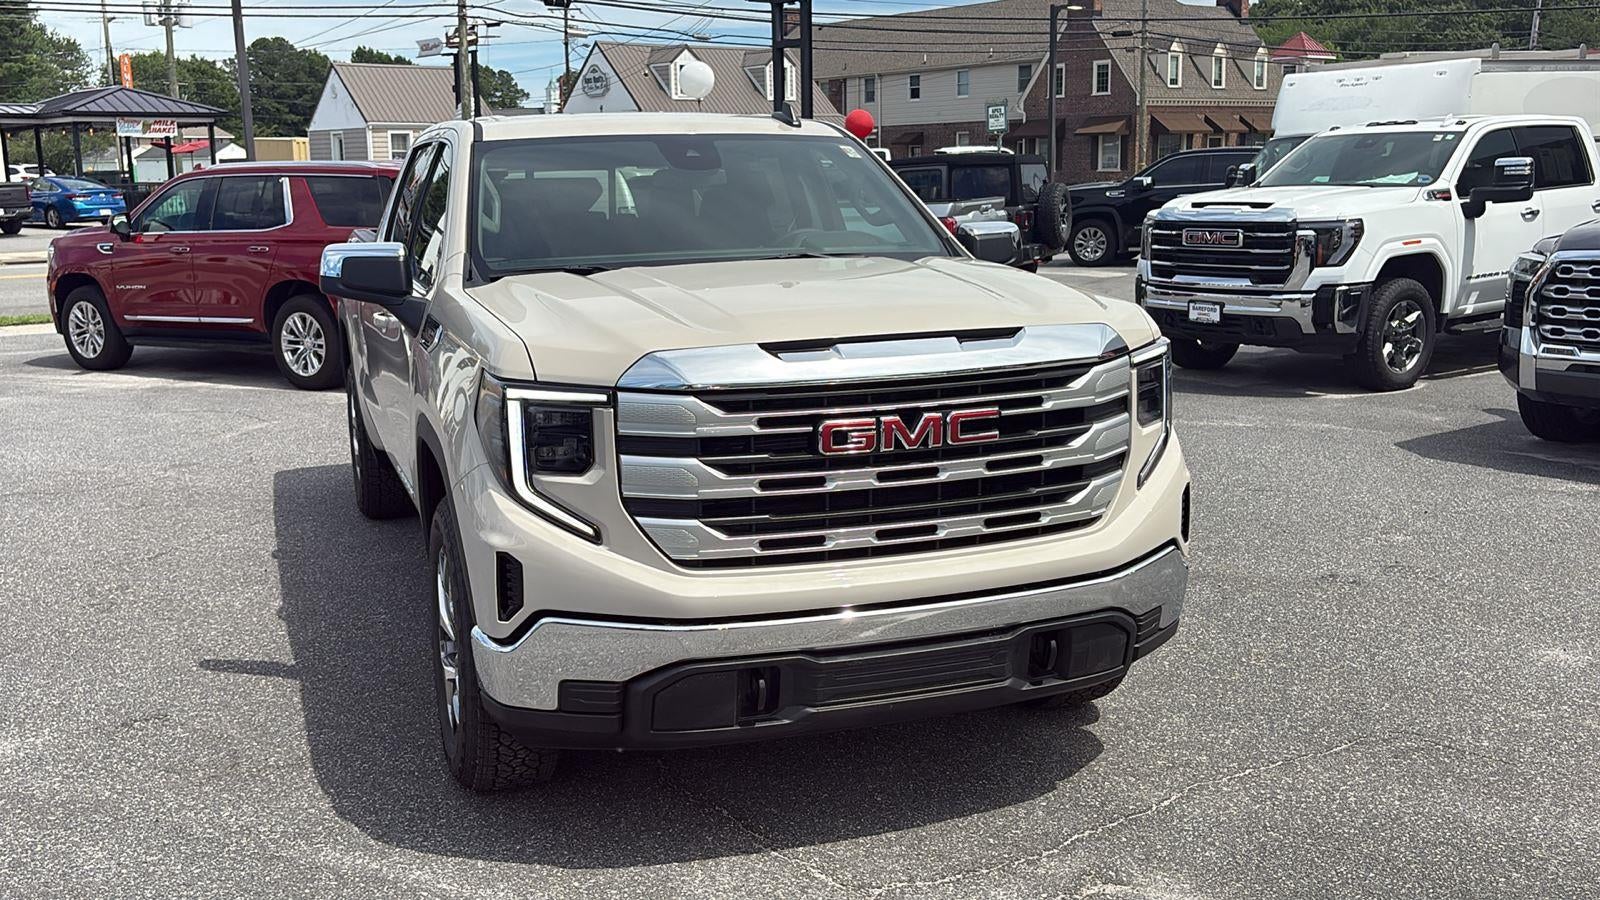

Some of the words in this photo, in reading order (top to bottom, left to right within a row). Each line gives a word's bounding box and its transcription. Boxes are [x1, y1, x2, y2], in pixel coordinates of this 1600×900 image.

[1184, 231, 1238, 244] GMC
[1192, 305, 1218, 313] BAREFORD
[818, 406, 999, 455] GMC
